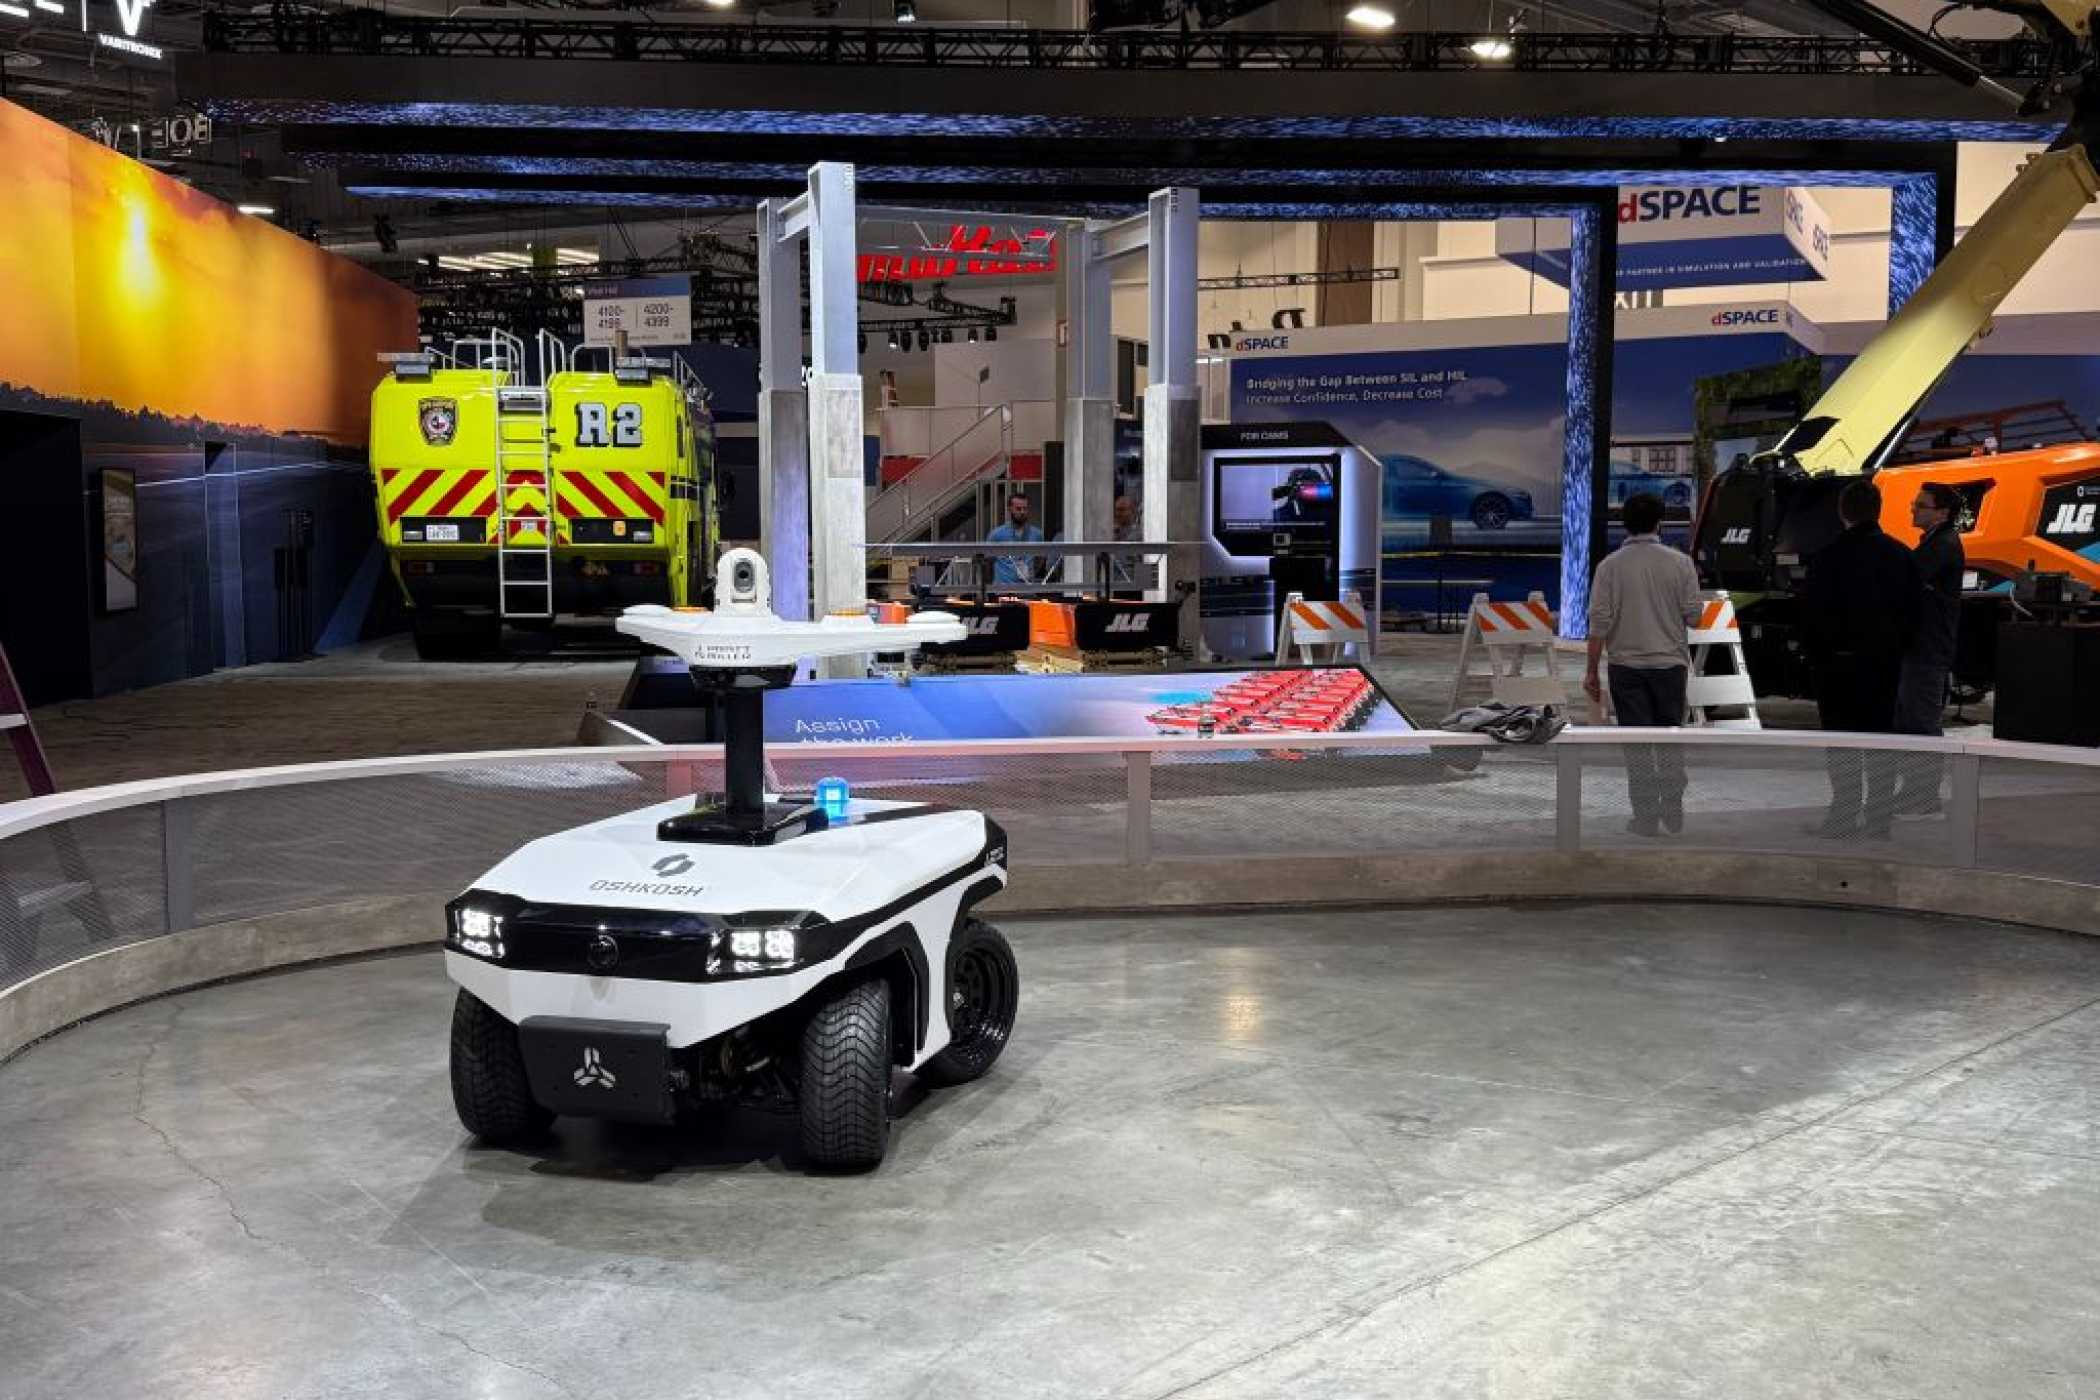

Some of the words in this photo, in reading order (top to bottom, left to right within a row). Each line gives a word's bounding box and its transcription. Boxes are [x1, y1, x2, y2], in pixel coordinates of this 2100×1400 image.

[1617, 185, 1760, 225] dSPACE
[1711, 308, 1780, 328] dSPACE
[1235, 336, 1289, 352] dSPACE
[1246, 376, 1295, 391] Bridging
[1297, 376, 1317, 388] the
[1320, 374, 1342, 389] Gap
[1344, 373, 1398, 386] Between
[1421, 370, 1445, 383] and
[1246, 393, 1291, 406] Increase
[1293, 390, 1359, 404] Confidence,
[1362, 389, 1414, 401] Decrease
[1417, 387, 1443, 400] Cost
[576, 400, 643, 448] R2
[2046, 503, 2097, 534] JLG
[1721, 528, 1752, 544] JLG
[1104, 613, 1150, 633] JLG
[796, 717, 881, 734] Assign
[589, 879, 704, 896] OSHKOSH
